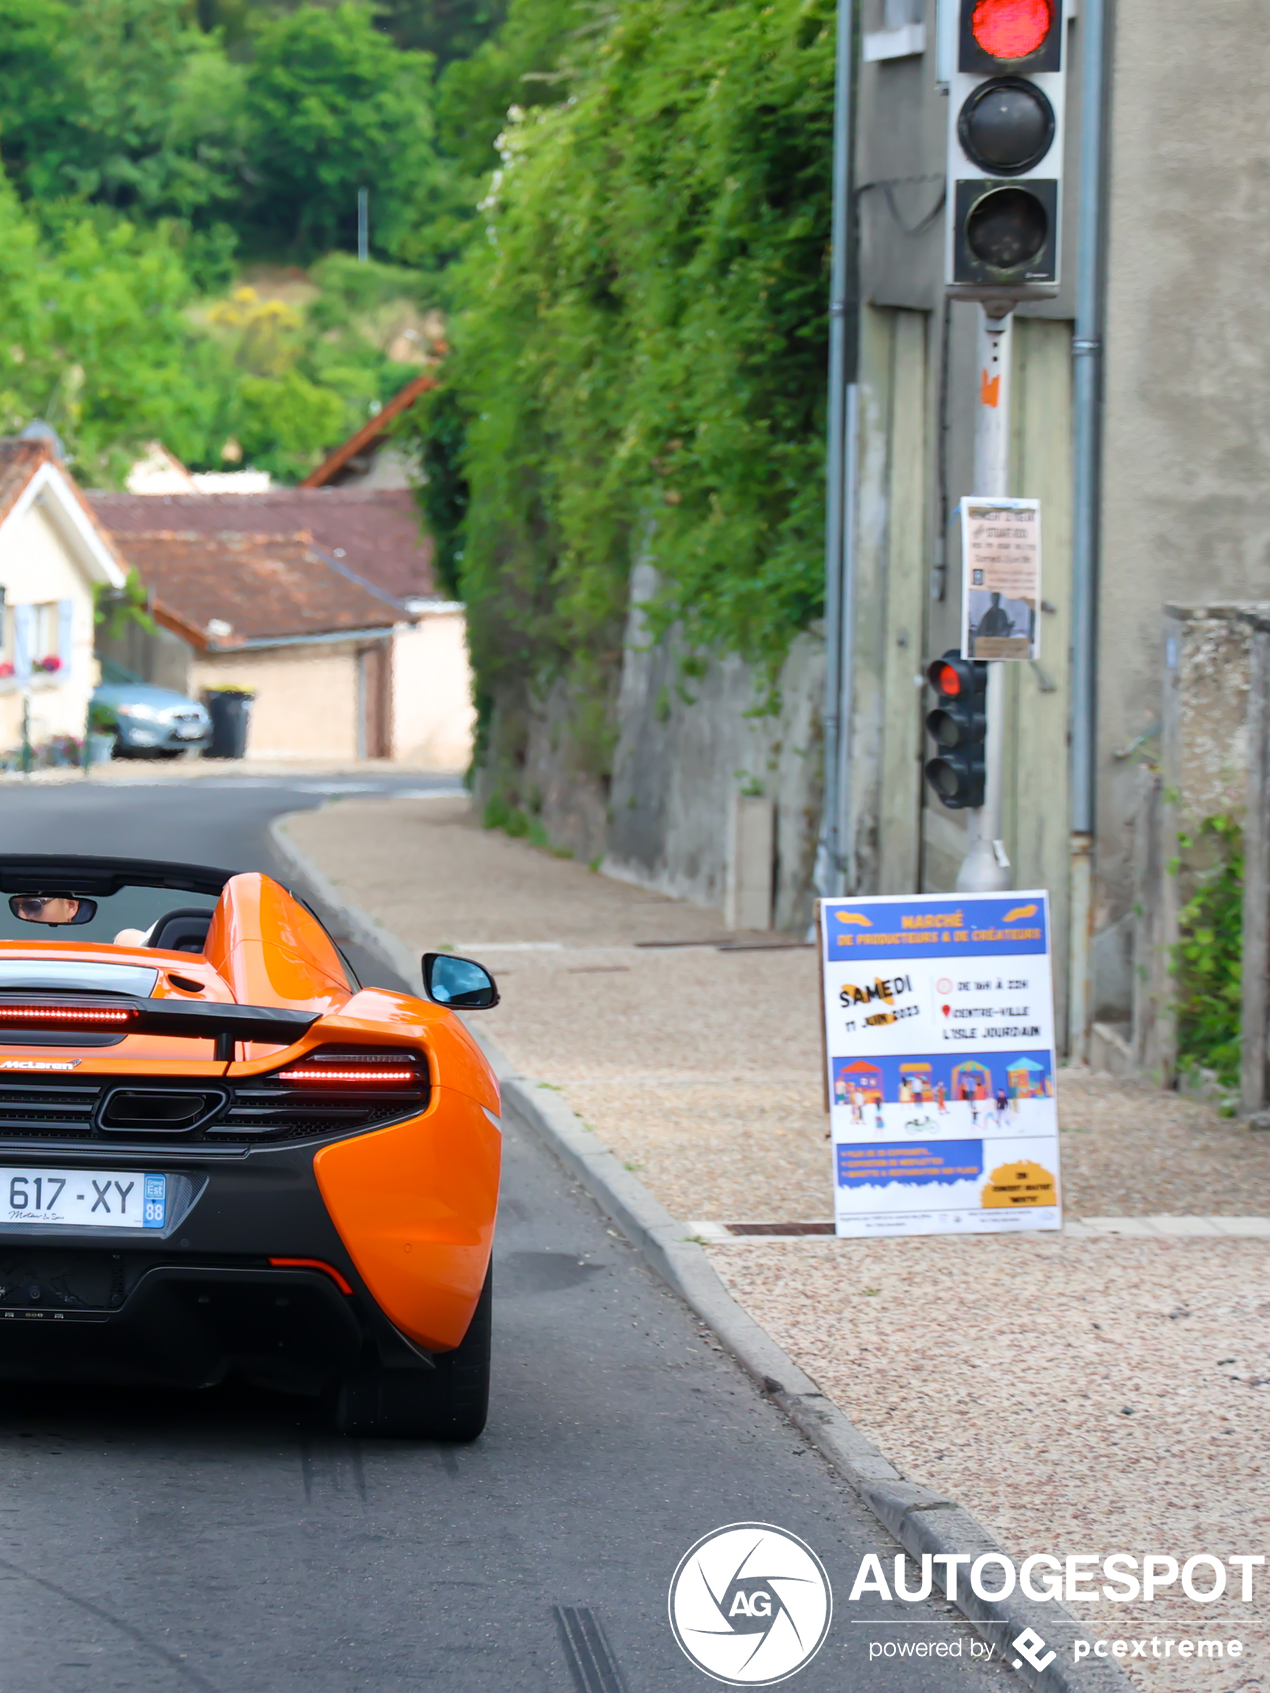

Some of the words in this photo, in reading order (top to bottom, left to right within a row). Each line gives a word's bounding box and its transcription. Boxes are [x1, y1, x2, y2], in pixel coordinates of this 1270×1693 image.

[902, 910, 964, 929] MARCHÉ
[837, 935, 854, 946] DE
[856, 931, 939, 945] PRODUCTEURS
[953, 930, 969, 942] DE
[971, 926, 1042, 942] CRÉATEURS
[839, 974, 912, 1008] SAMEDI
[147, 1185, 163, 1196] Est
[145, 1203, 163, 1221] 88
